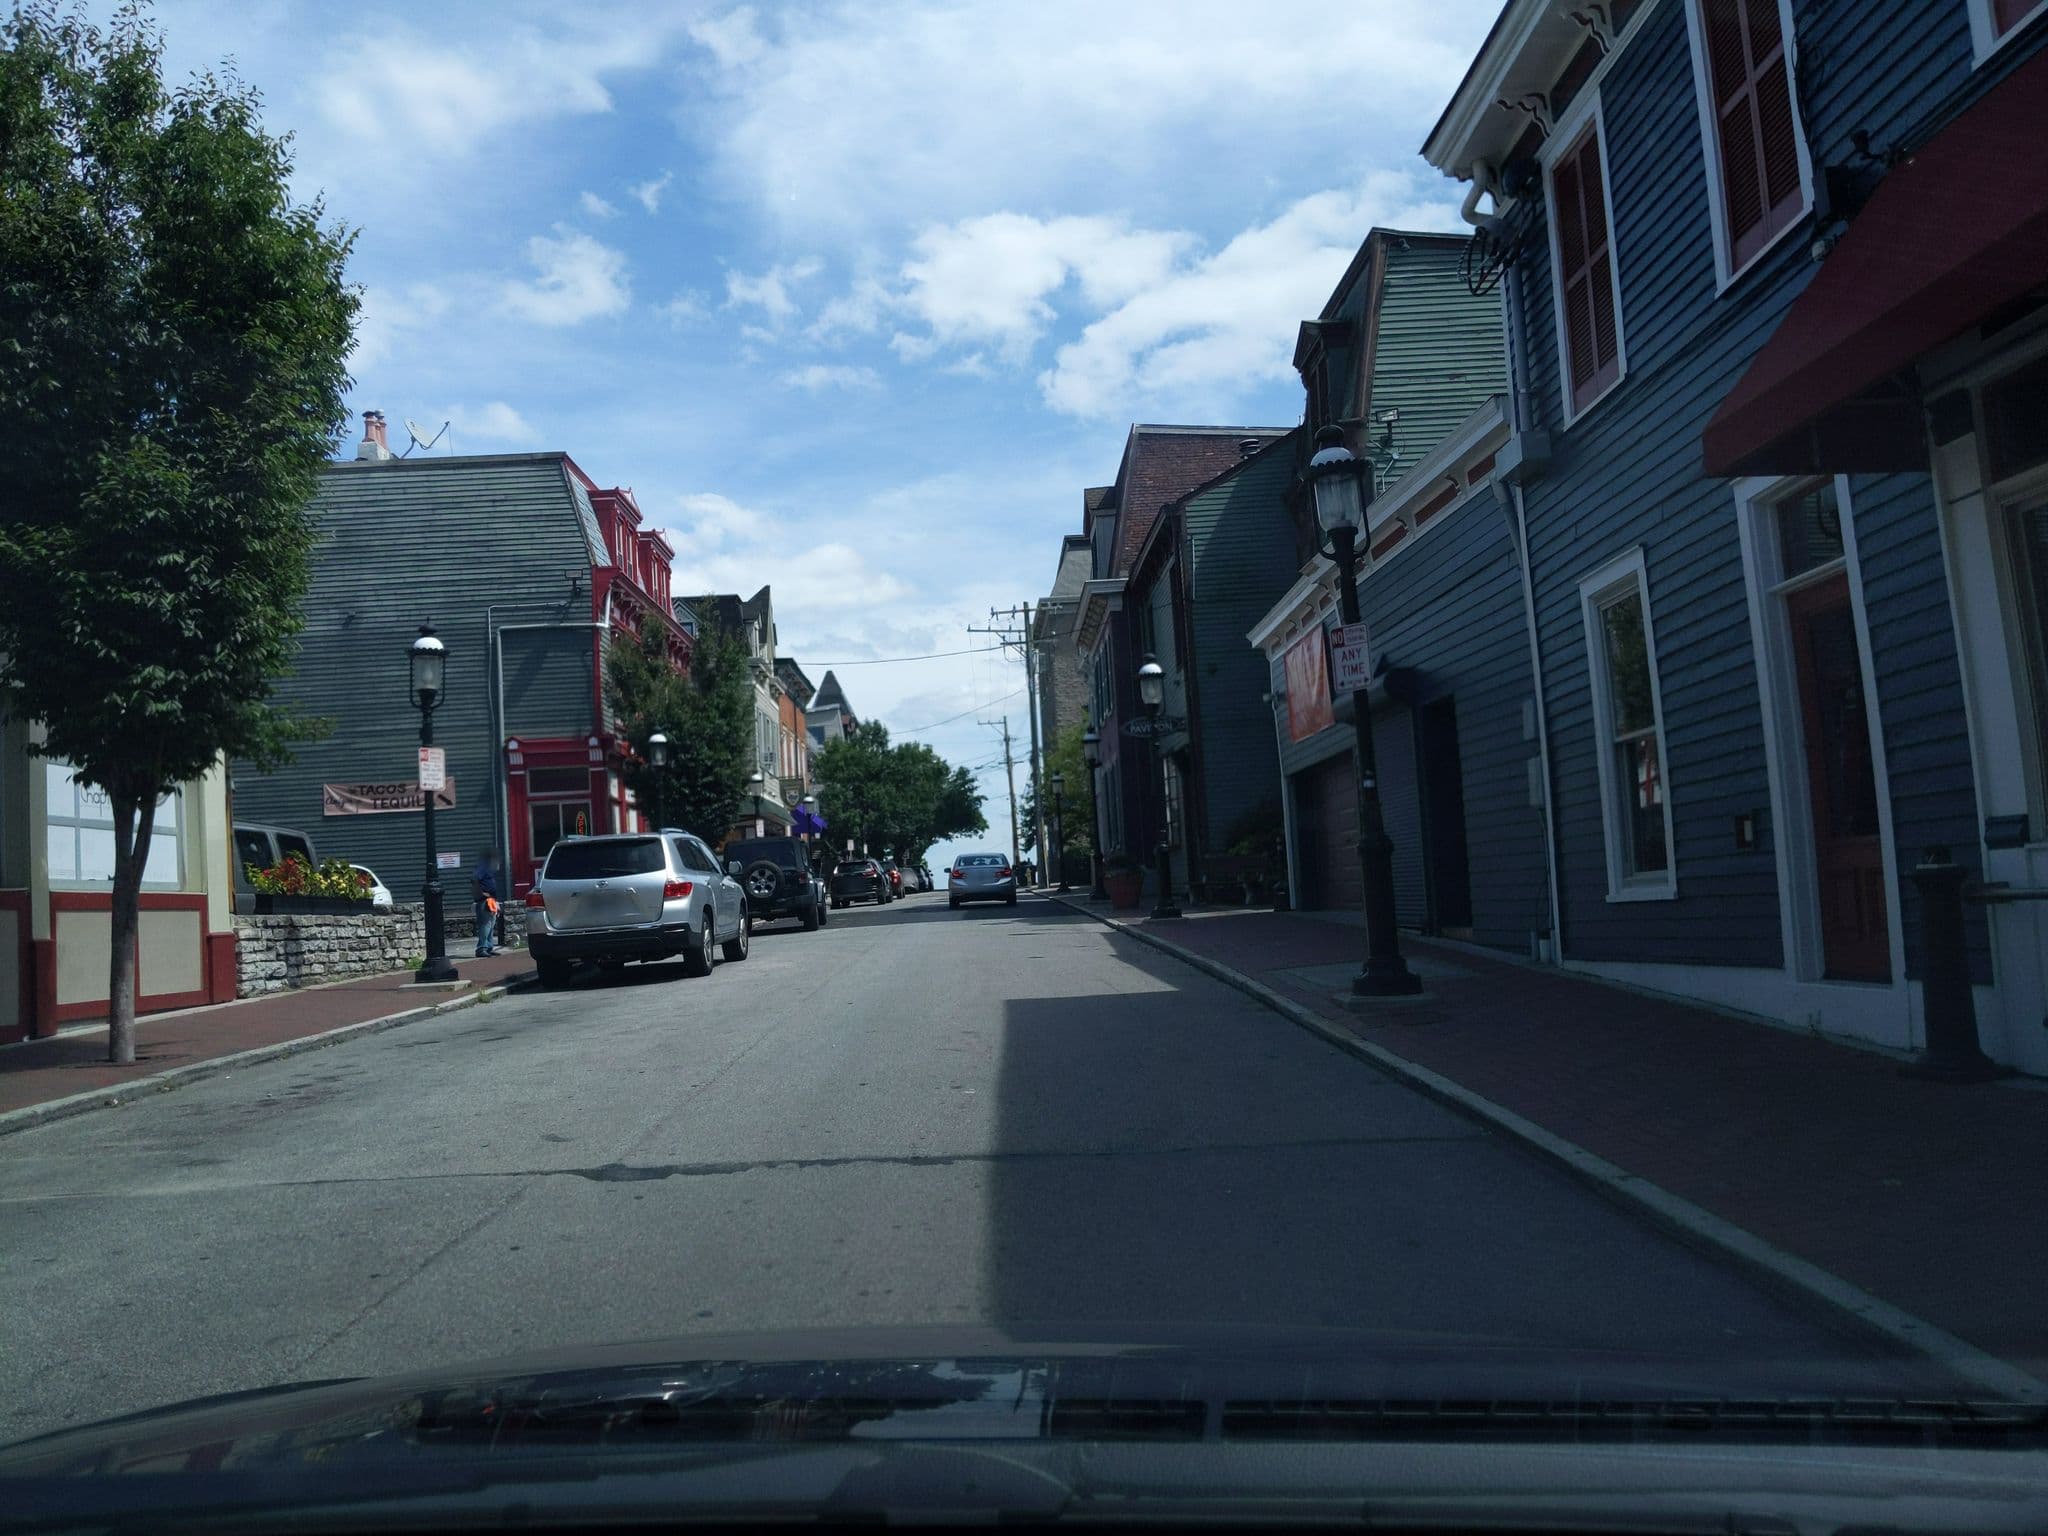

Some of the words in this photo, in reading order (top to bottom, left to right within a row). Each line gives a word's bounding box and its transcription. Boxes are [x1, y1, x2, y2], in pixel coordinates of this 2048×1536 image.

[1332, 631, 1344, 645] NO
[1341, 647, 1362, 662] ANY
[1341, 663, 1365, 677] TIME
[359, 783, 407, 795] TACOS
[371, 795, 426, 809] TEQUIL
